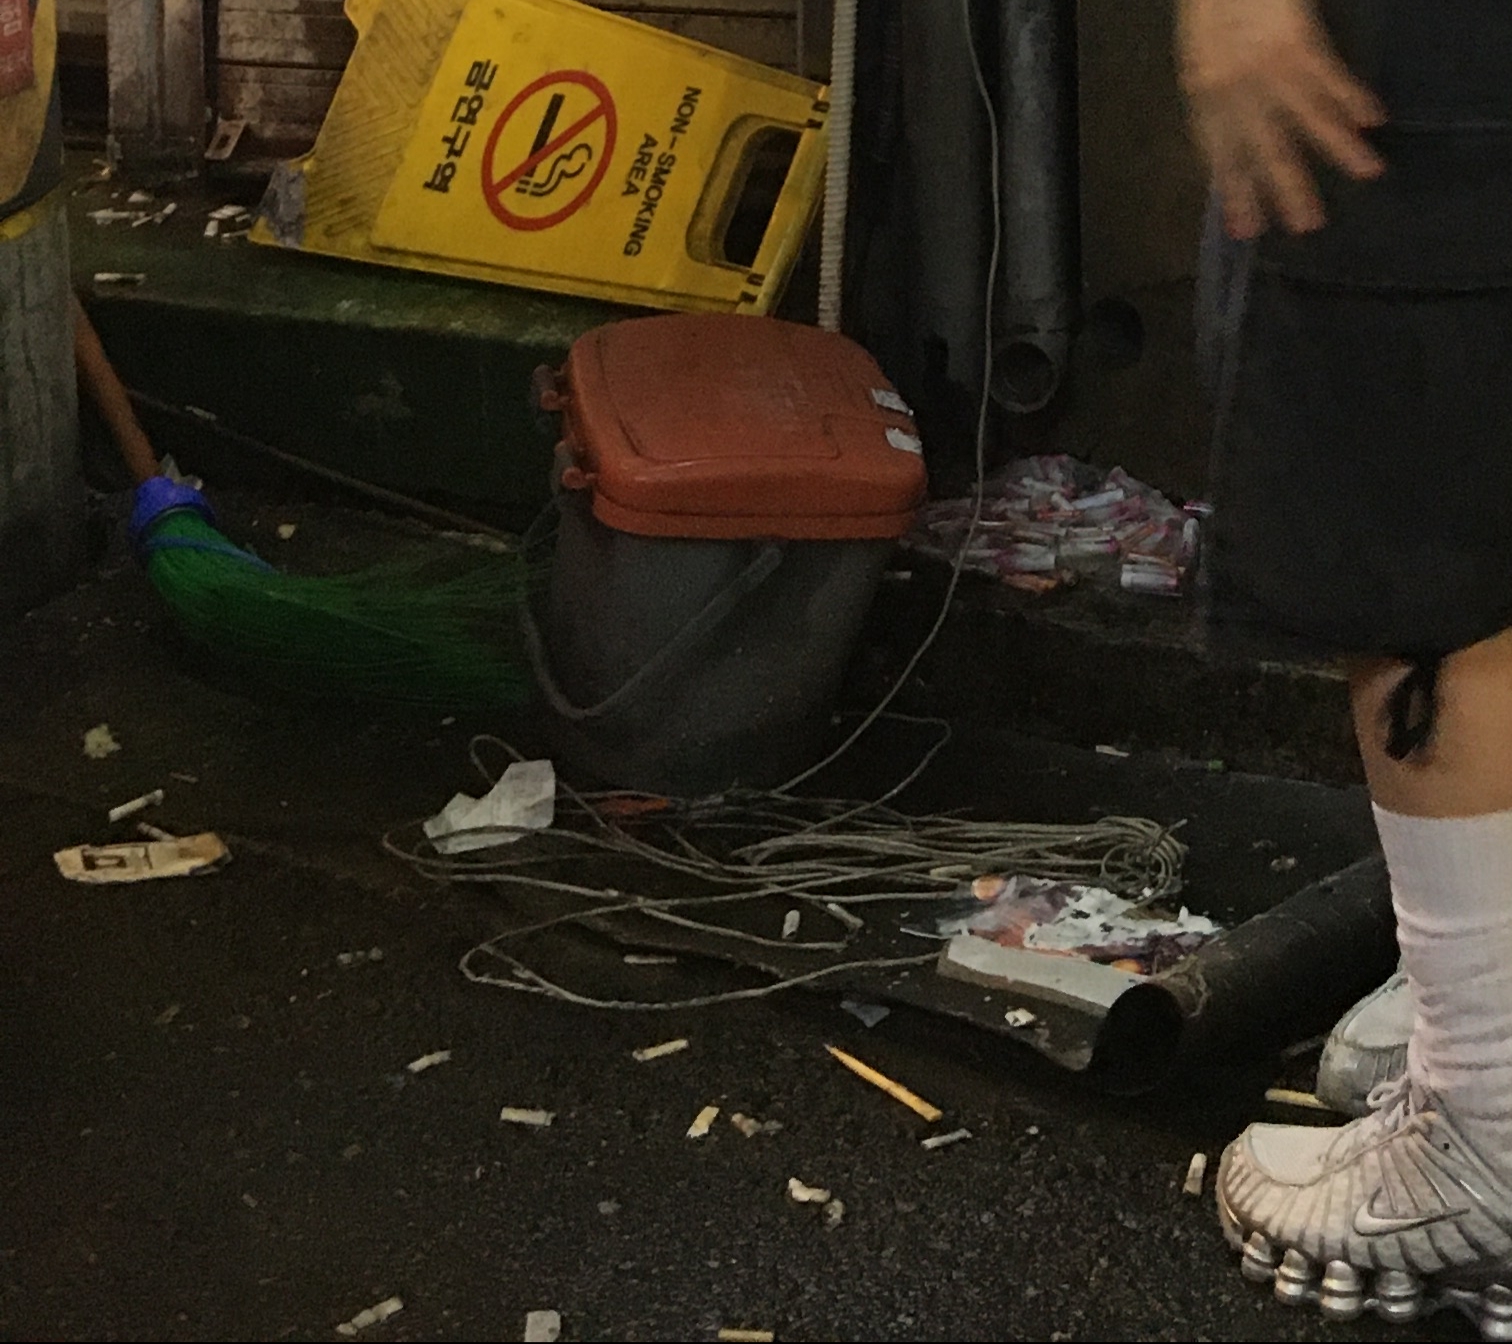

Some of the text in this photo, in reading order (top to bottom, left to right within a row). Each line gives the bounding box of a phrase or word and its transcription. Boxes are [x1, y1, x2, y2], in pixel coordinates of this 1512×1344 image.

[422, 58, 497, 194] 금연구역
[620, 133, 657, 198] AREA
[621, 85, 701, 258] NON-SMOKING
